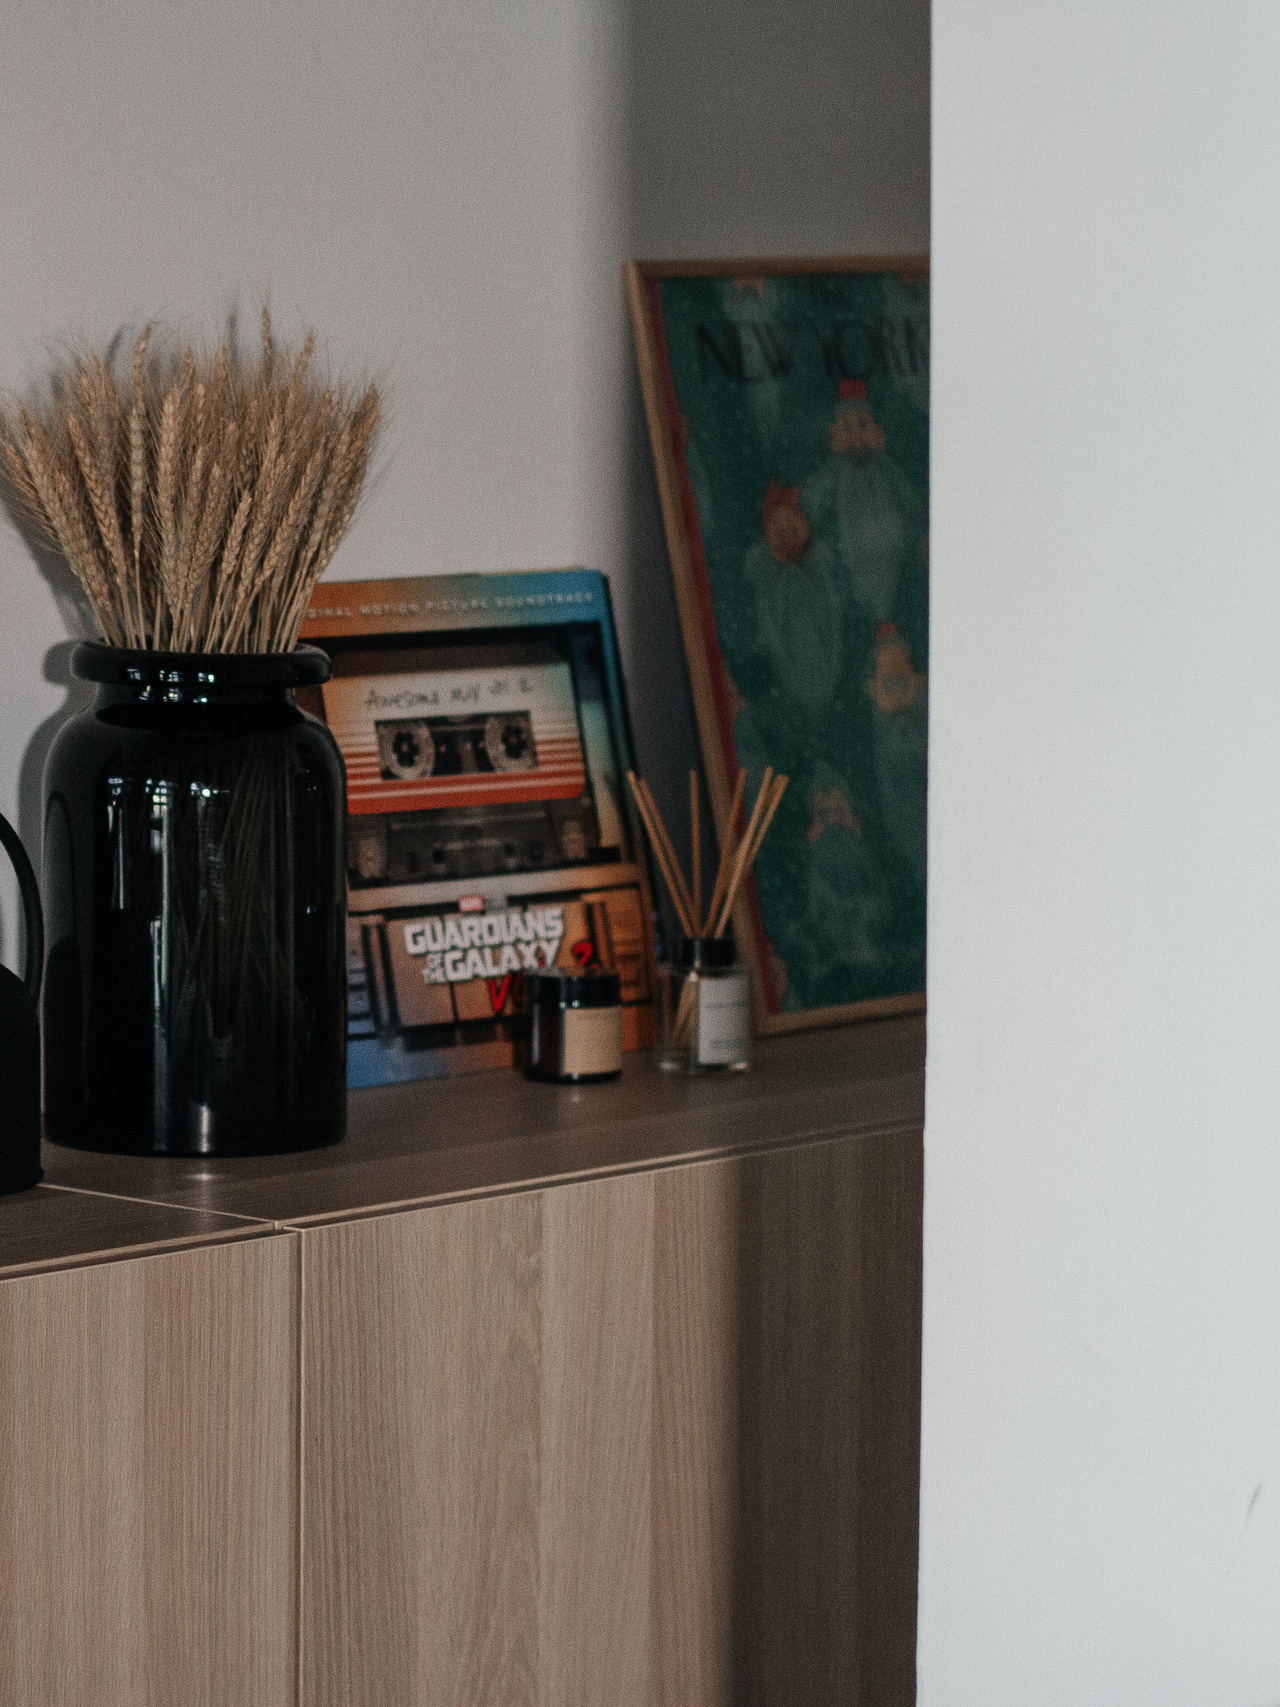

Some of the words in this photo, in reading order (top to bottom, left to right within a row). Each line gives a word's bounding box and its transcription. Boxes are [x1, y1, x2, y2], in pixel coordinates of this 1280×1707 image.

[695, 318, 796, 384] NEW
[358, 603, 419, 616] MOTION
[425, 597, 488, 611] PICTURE
[494, 591, 594, 607] SOUNDTRACK
[403, 907, 566, 956] GUARDIANS
[443, 940, 562, 983] GALAXY
